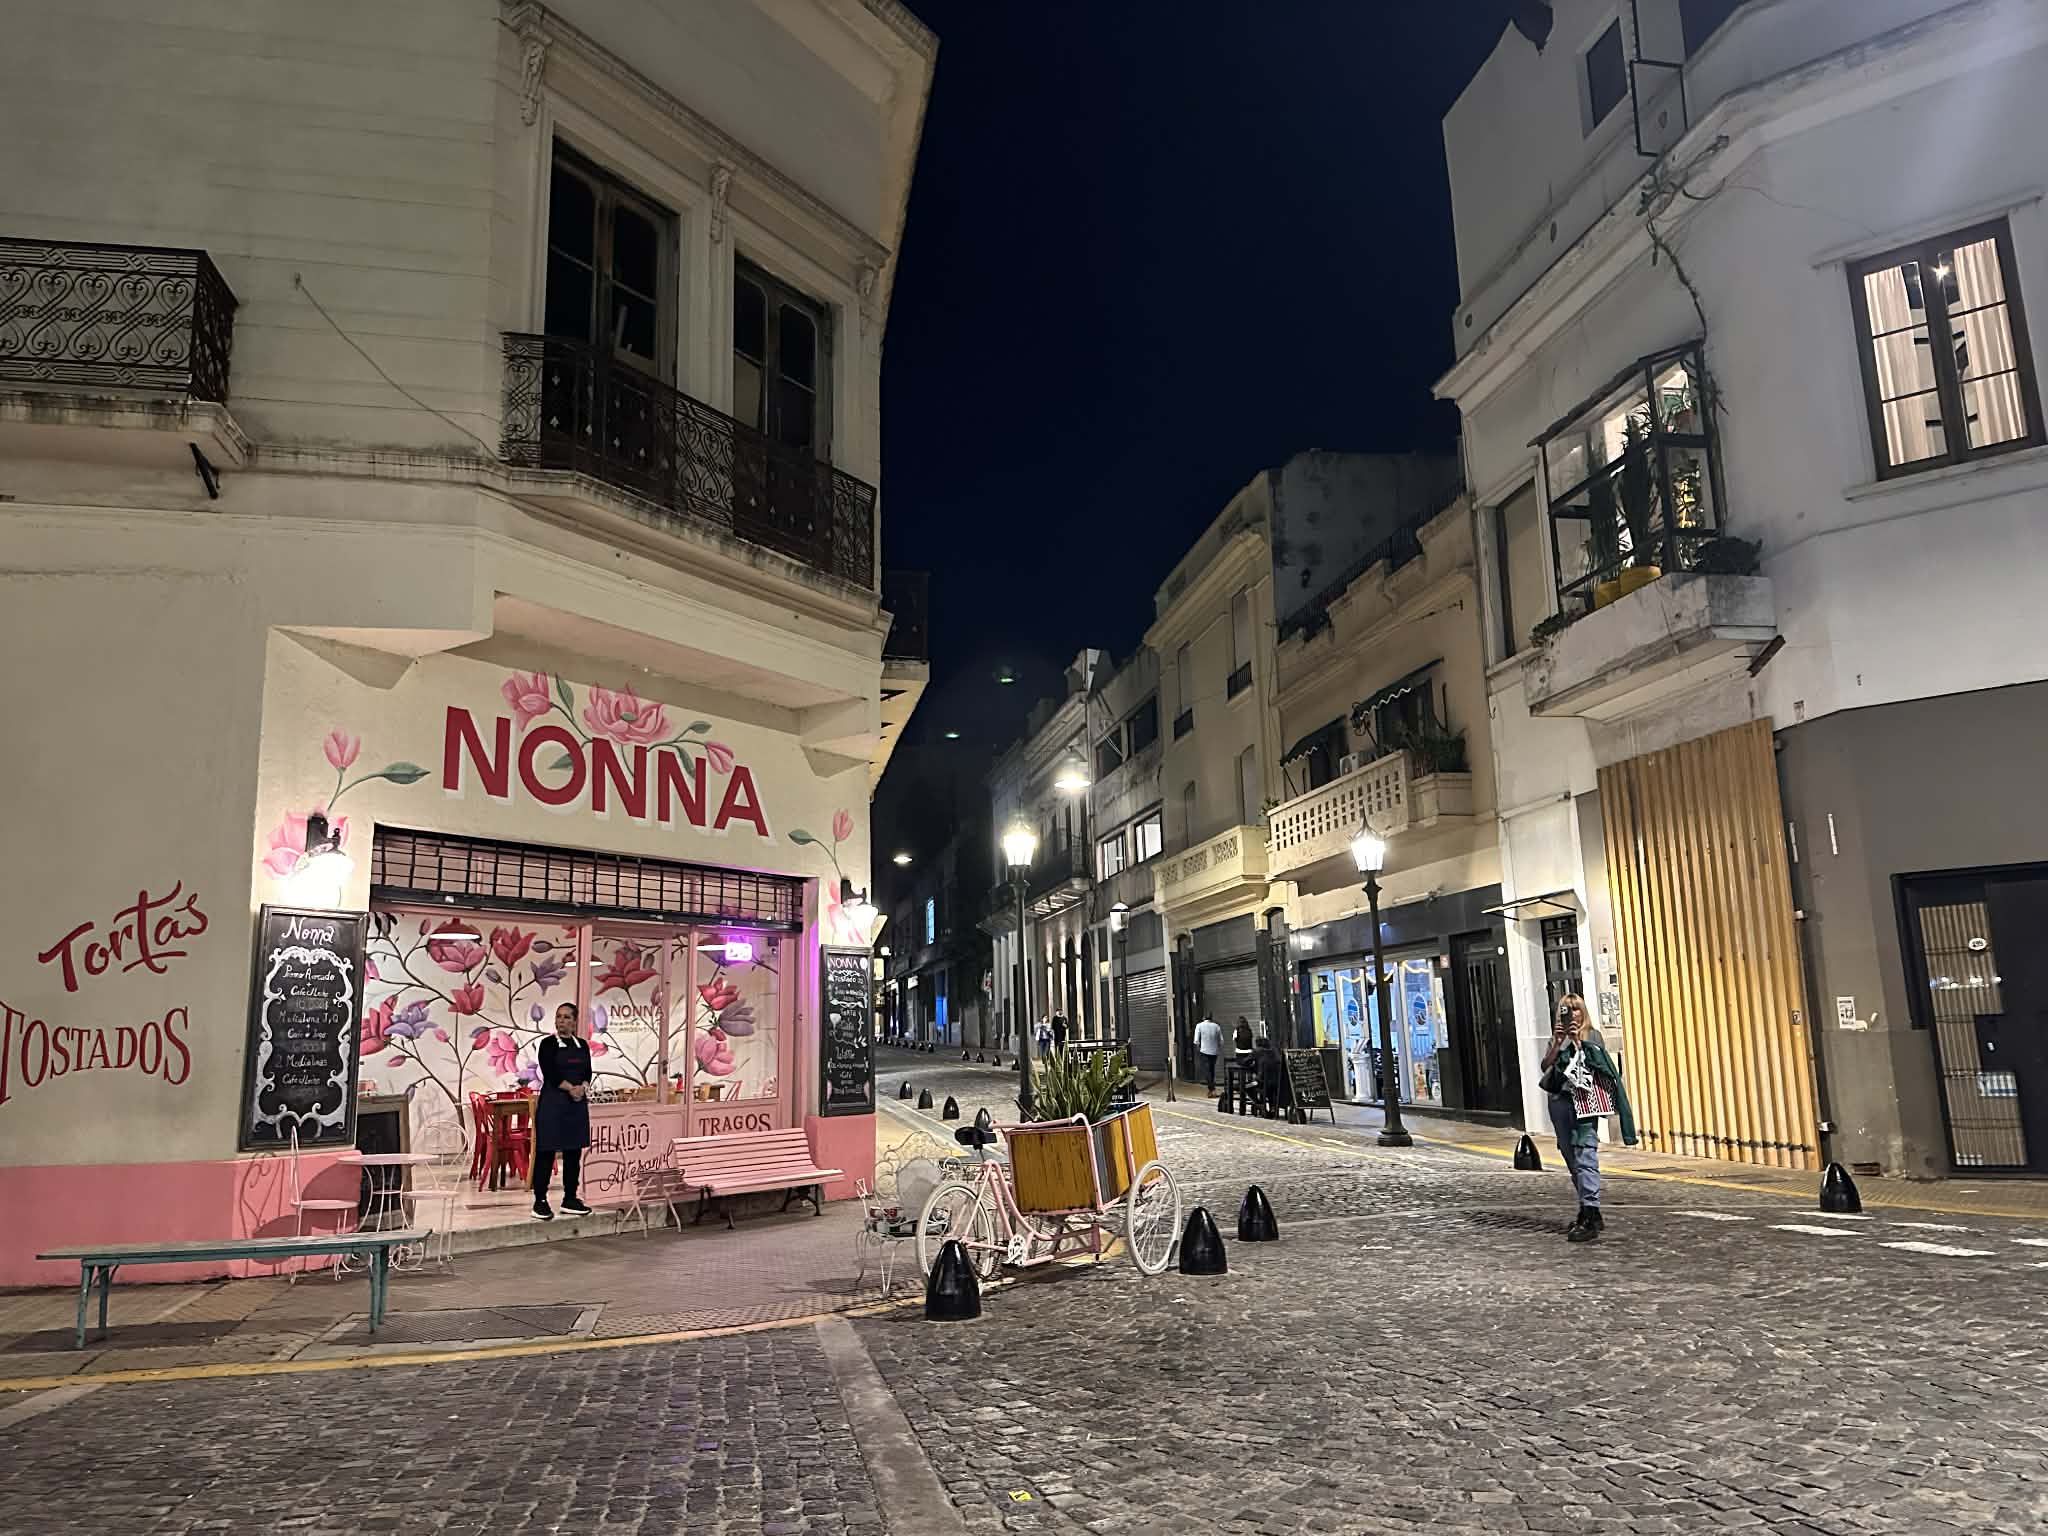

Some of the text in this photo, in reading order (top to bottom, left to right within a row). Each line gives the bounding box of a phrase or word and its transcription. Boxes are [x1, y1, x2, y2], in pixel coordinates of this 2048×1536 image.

[443, 705, 772, 839] NONNA
[38, 880, 208, 992] Tortas
[281, 916, 334, 945] Nonna
[830, 957, 859, 969] NONNA
[610, 1005, 665, 1018] NONNA
[0, 1003, 191, 1103] TOSTADOS
[590, 1123, 650, 1154] HELADO
[700, 1113, 772, 1136] TRAGOS
